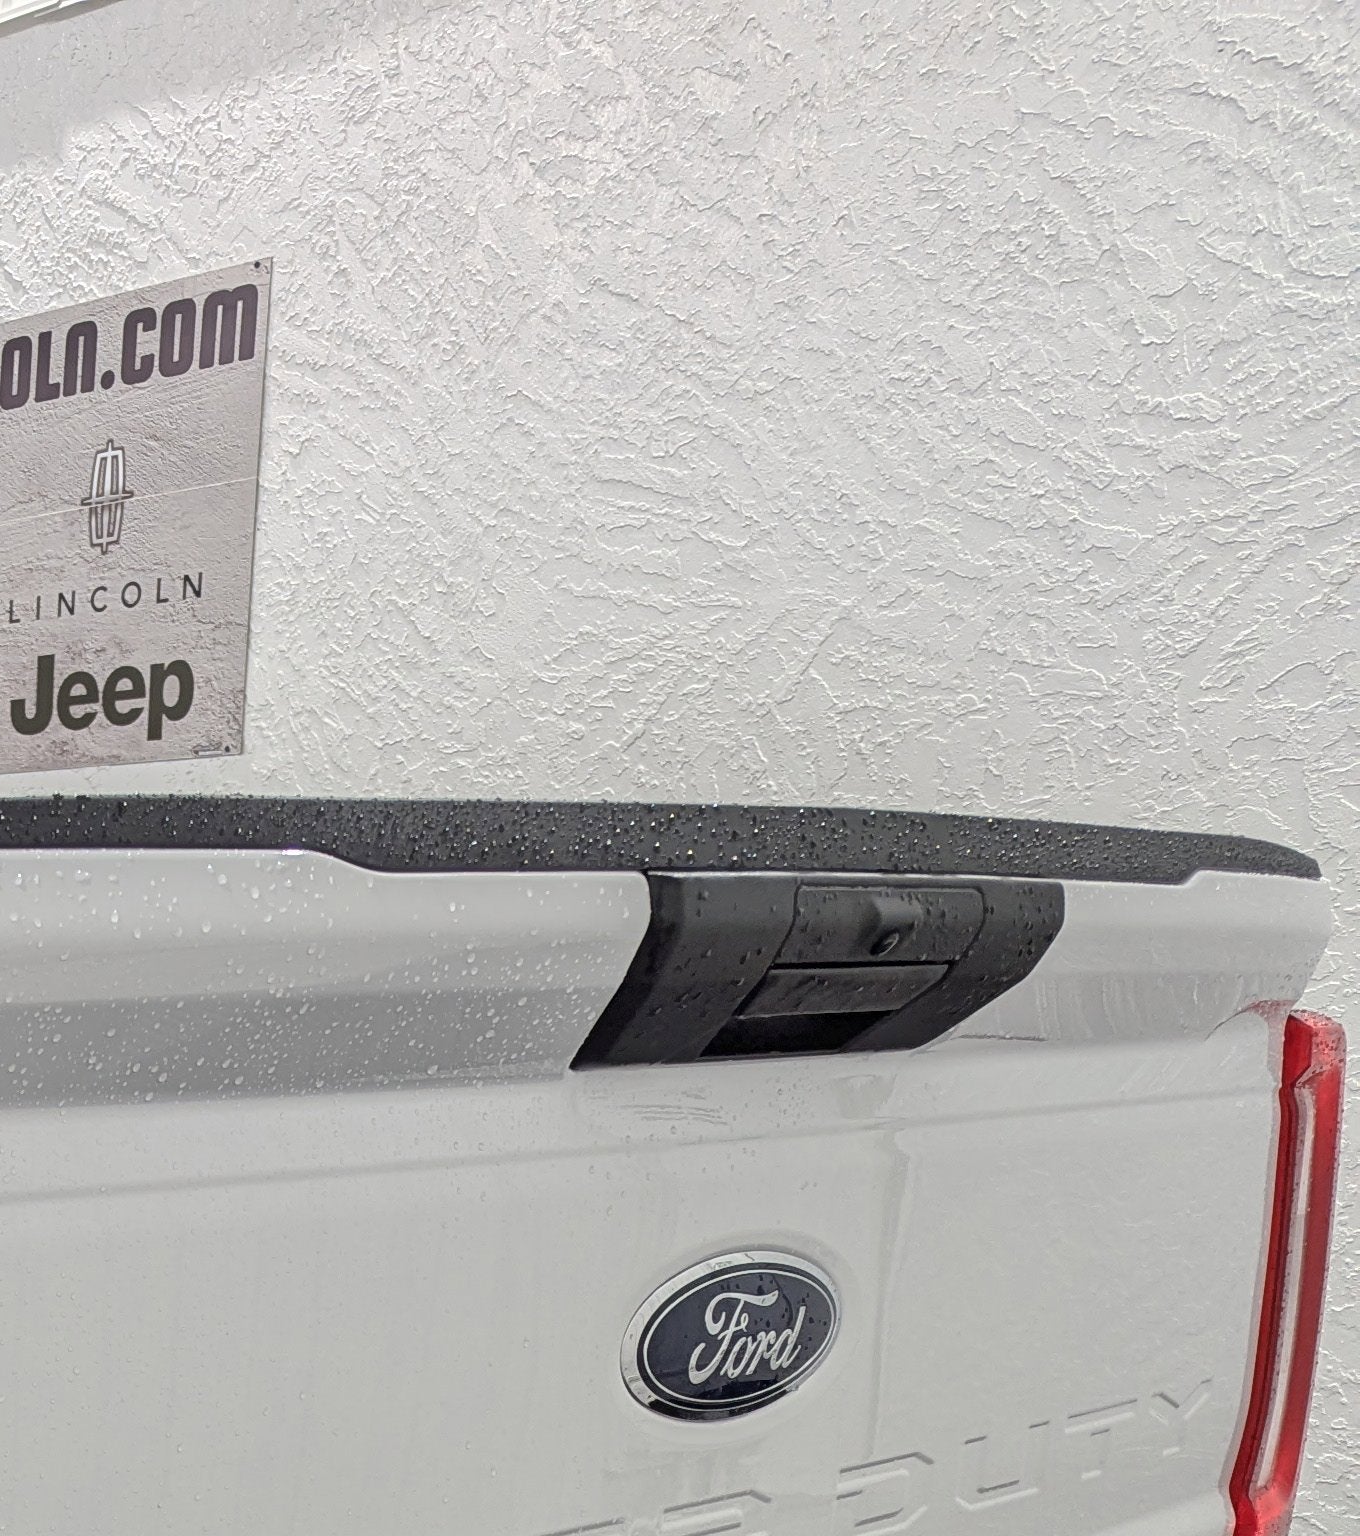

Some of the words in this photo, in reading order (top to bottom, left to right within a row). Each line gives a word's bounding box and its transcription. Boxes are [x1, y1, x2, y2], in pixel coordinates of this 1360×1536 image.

[9, 572, 203, 624] LINCOLN
[10, 654, 194, 741] Jeep
[688, 1290, 807, 1385] Ford
